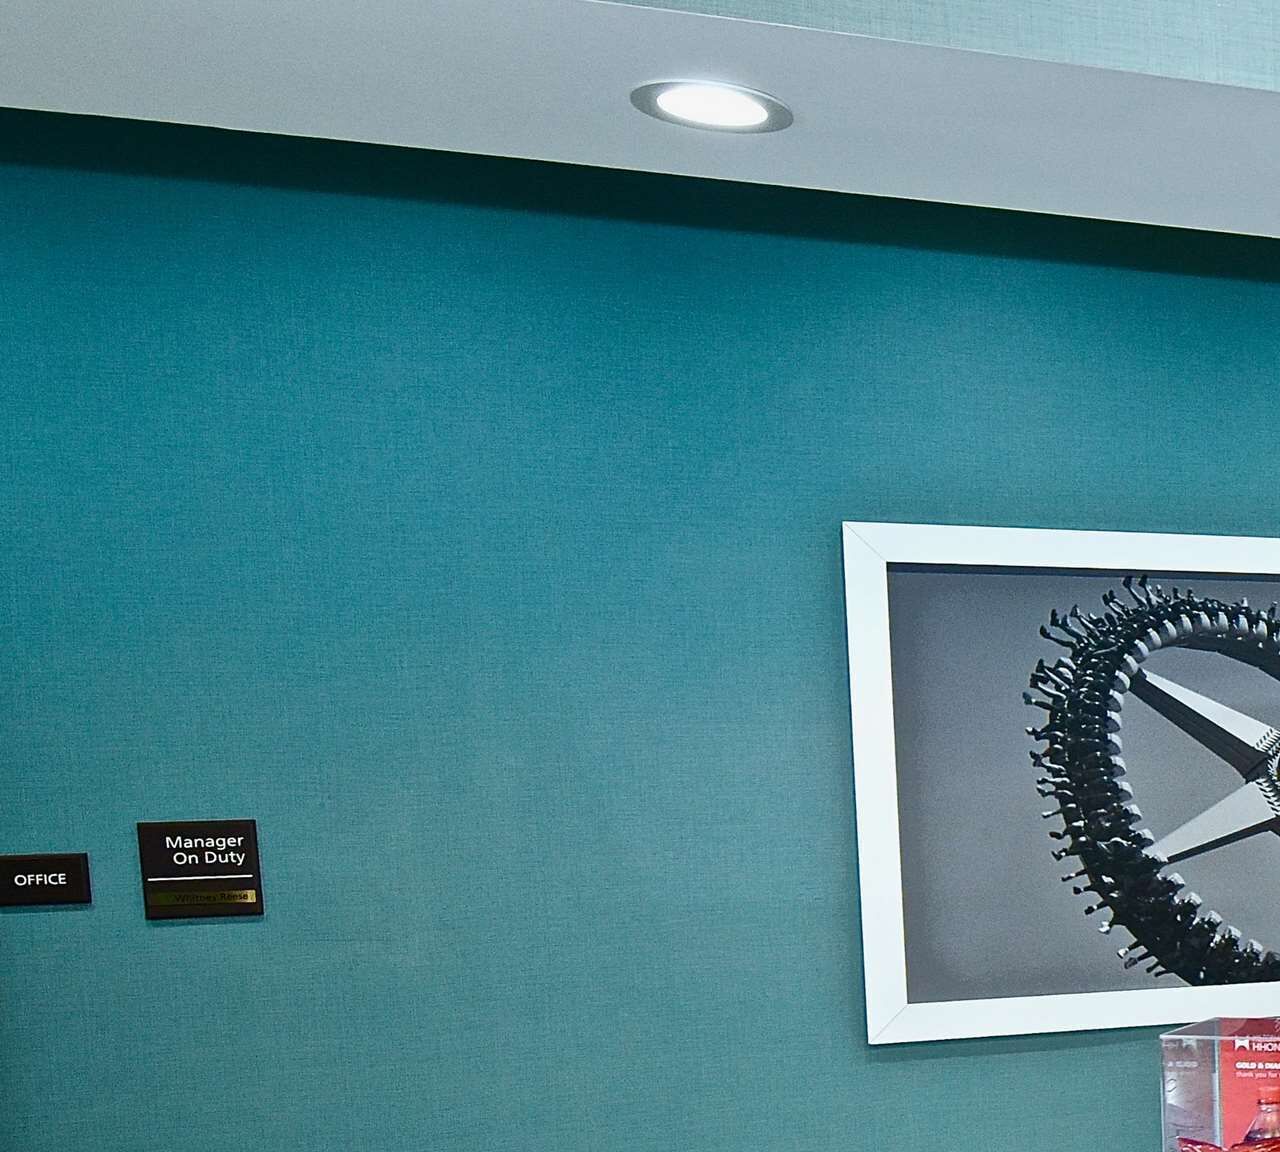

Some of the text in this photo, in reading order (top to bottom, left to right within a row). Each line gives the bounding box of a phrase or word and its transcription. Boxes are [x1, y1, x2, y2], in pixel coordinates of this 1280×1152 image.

[165, 836, 244, 850] Manager
[172, 851, 246, 866] On Duty
[14, 872, 68, 886] OFFICE
[1235, 1062, 1257, 1070] GOLD
